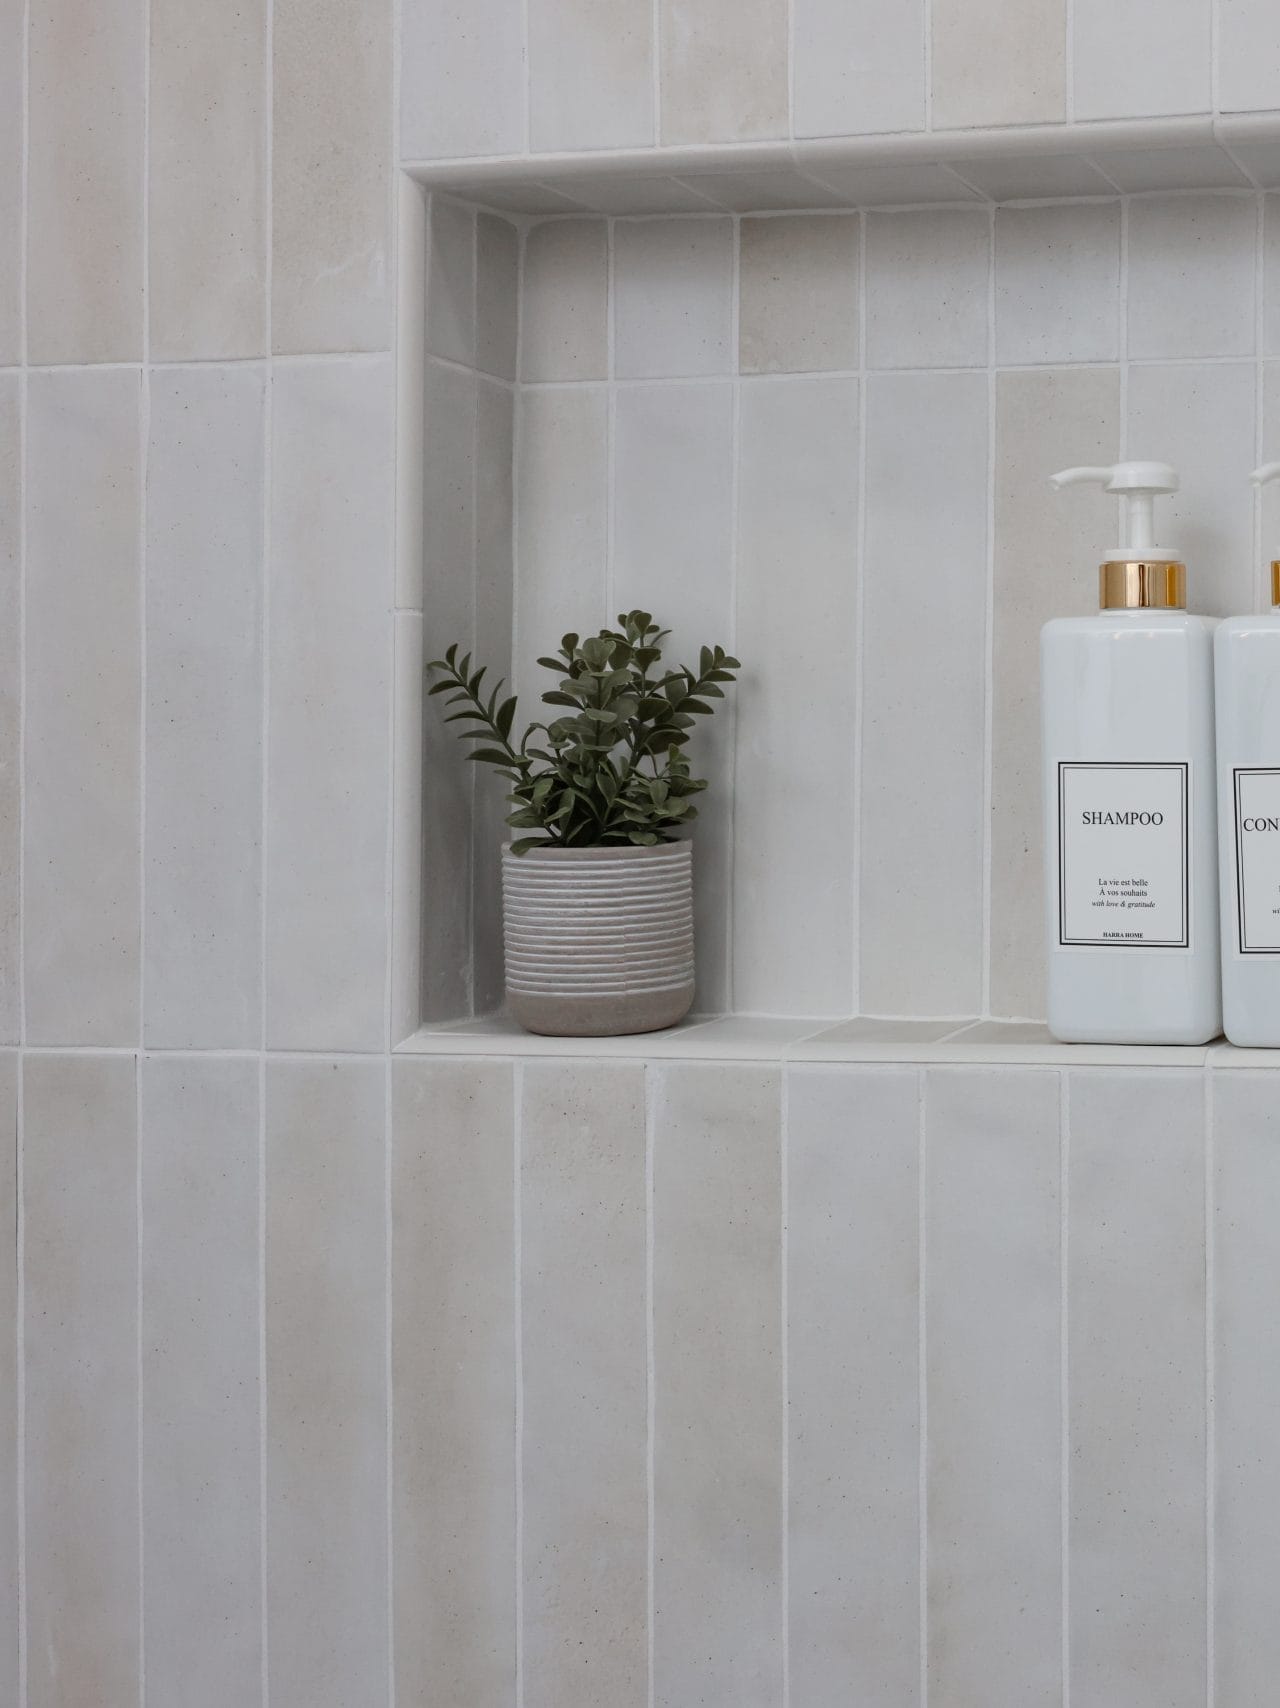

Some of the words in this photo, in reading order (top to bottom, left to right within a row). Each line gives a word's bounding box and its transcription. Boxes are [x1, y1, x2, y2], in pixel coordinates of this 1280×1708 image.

[1081, 811, 1164, 826] SHAMPOO
[1098, 878, 1107, 886] La
[1109, 878, 1119, 886] vie
[1132, 879, 1148, 887] belle
[1128, 900, 1155, 909] gratitude
